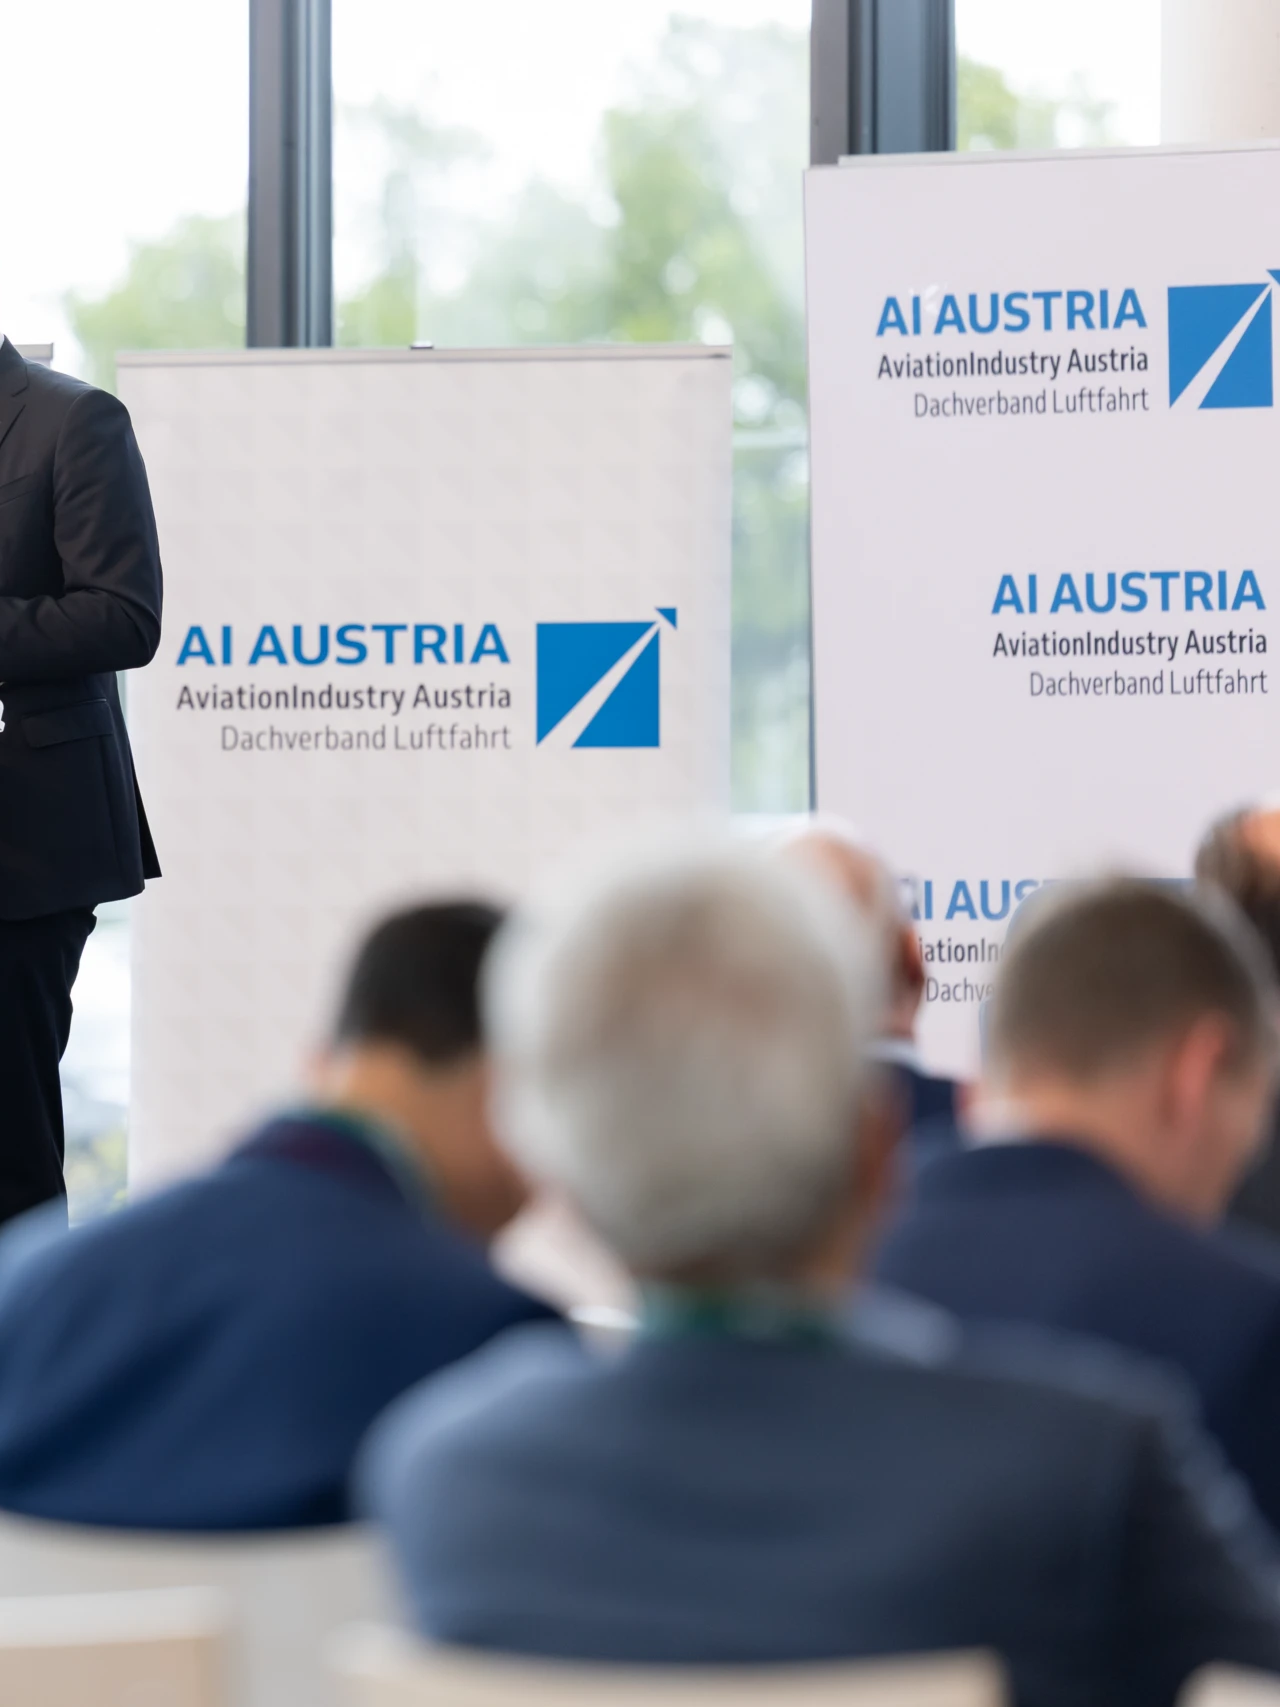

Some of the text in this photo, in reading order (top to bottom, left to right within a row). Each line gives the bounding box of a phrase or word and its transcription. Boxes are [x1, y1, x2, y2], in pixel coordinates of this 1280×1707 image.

[876, 289, 1148, 337] AI AUSTRIA
[877, 347, 1148, 381] AviationIndustry Austria
[914, 386, 1149, 418] Dachverband Luftfahrt
[991, 569, 1267, 615] AI AUSTRIA
[176, 623, 510, 666] AI AUSTRIA
[992, 628, 1268, 662] AviationIndustry Austria
[1030, 667, 1268, 697] Dachverband Luftfahrt
[176, 683, 511, 716] AviationIndustry Austria
[221, 723, 511, 751] Dachverband Luftfahrt
